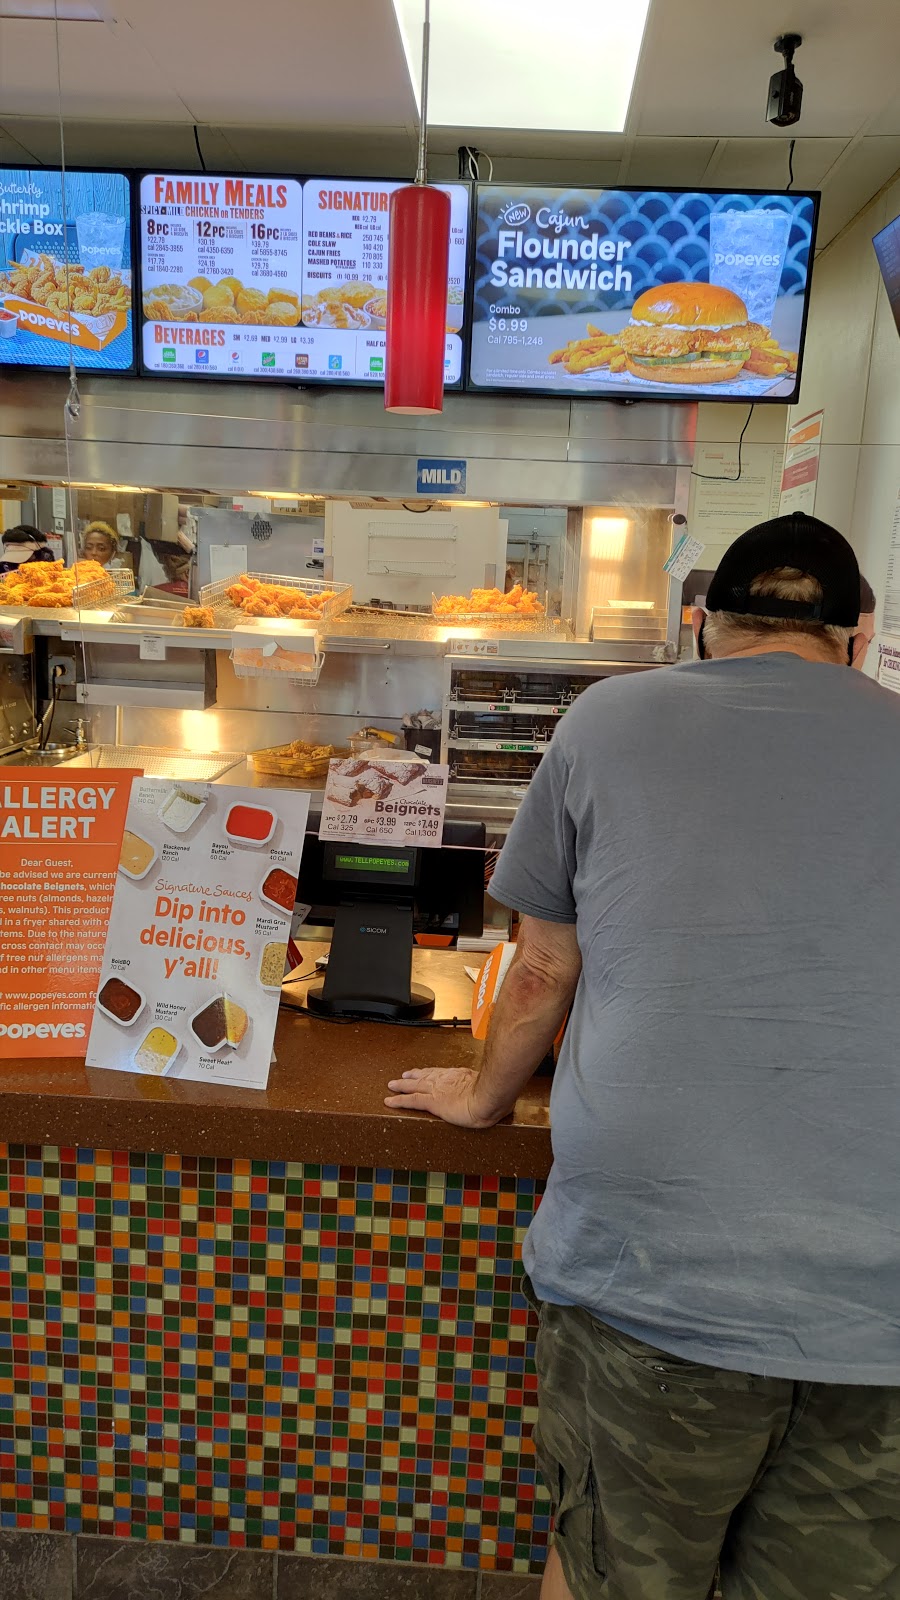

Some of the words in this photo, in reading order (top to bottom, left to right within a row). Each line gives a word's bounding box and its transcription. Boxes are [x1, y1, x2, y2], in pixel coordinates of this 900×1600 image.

[154, 176, 220, 206] FAMILY
[225, 179, 288, 208] MEALS
[318, 190, 391, 212] SIGNATUR
[0, 199, 50, 218] hrimp
[185, 206, 220, 218] CHICKEN
[220, 210, 229, 219] OR
[230, 208, 264, 220] TENDERS
[536, 207, 590, 234] Cajun
[34, 220, 64, 236] Box
[498, 230, 632, 262] Flounder
[307, 272, 332, 280] BISCUITS
[490, 260, 632, 292] Sandwich
[489, 304, 521, 314] Combo
[488, 316, 528, 332] $6.99
[154, 324, 226, 346] BEVERAGES
[488, 335, 502, 344] Cal
[422, 468, 462, 484] MILD
[0, 786, 116, 810] LLERGY
[374, 800, 441, 816] Beignets
[337, 814, 358, 824] $2.79
[376, 816, 396, 826] $3.99
[1, 816, 96, 838] ALERT
[378, 826, 394, 834] 650
[418, 820, 439, 830] $7.49
[163, 844, 190, 852] Blackened
[270, 848, 292, 857] Cocktail
[21, 858, 42, 867] Dear
[44, 858, 74, 868] Guest,
[13, 870, 48, 878] advised
[44, 882, 86, 891] Beignets,
[154, 878, 212, 896] Signature
[213, 884, 254, 902] Sauces
[39, 894, 84, 904] (almonds,
[8, 906, 50, 916] walnuts).
[52, 905, 72, 914] This
[74, 906, 110, 915] product
[154, 896, 194, 924] Dip
[198, 900, 246, 926] into
[4, 918, 14, 926] in
[23, 918, 46, 927] fryer
[48, 918, 80, 926] shared
[28, 930, 46, 938] Due
[28, 942, 63, 950] contact
[66, 943, 84, 951] may
[140, 924, 250, 960] delicious,
[6, 954, 26, 962] tree
[46, 953, 88, 962] allergens
[10, 966, 19, 974] in
[21, 965, 46, 974] other
[5, 992, 87, 1000] www.popeyes.com
[13, 1002, 50, 1012] allergen
[168, 1002, 186, 1011] Honey
